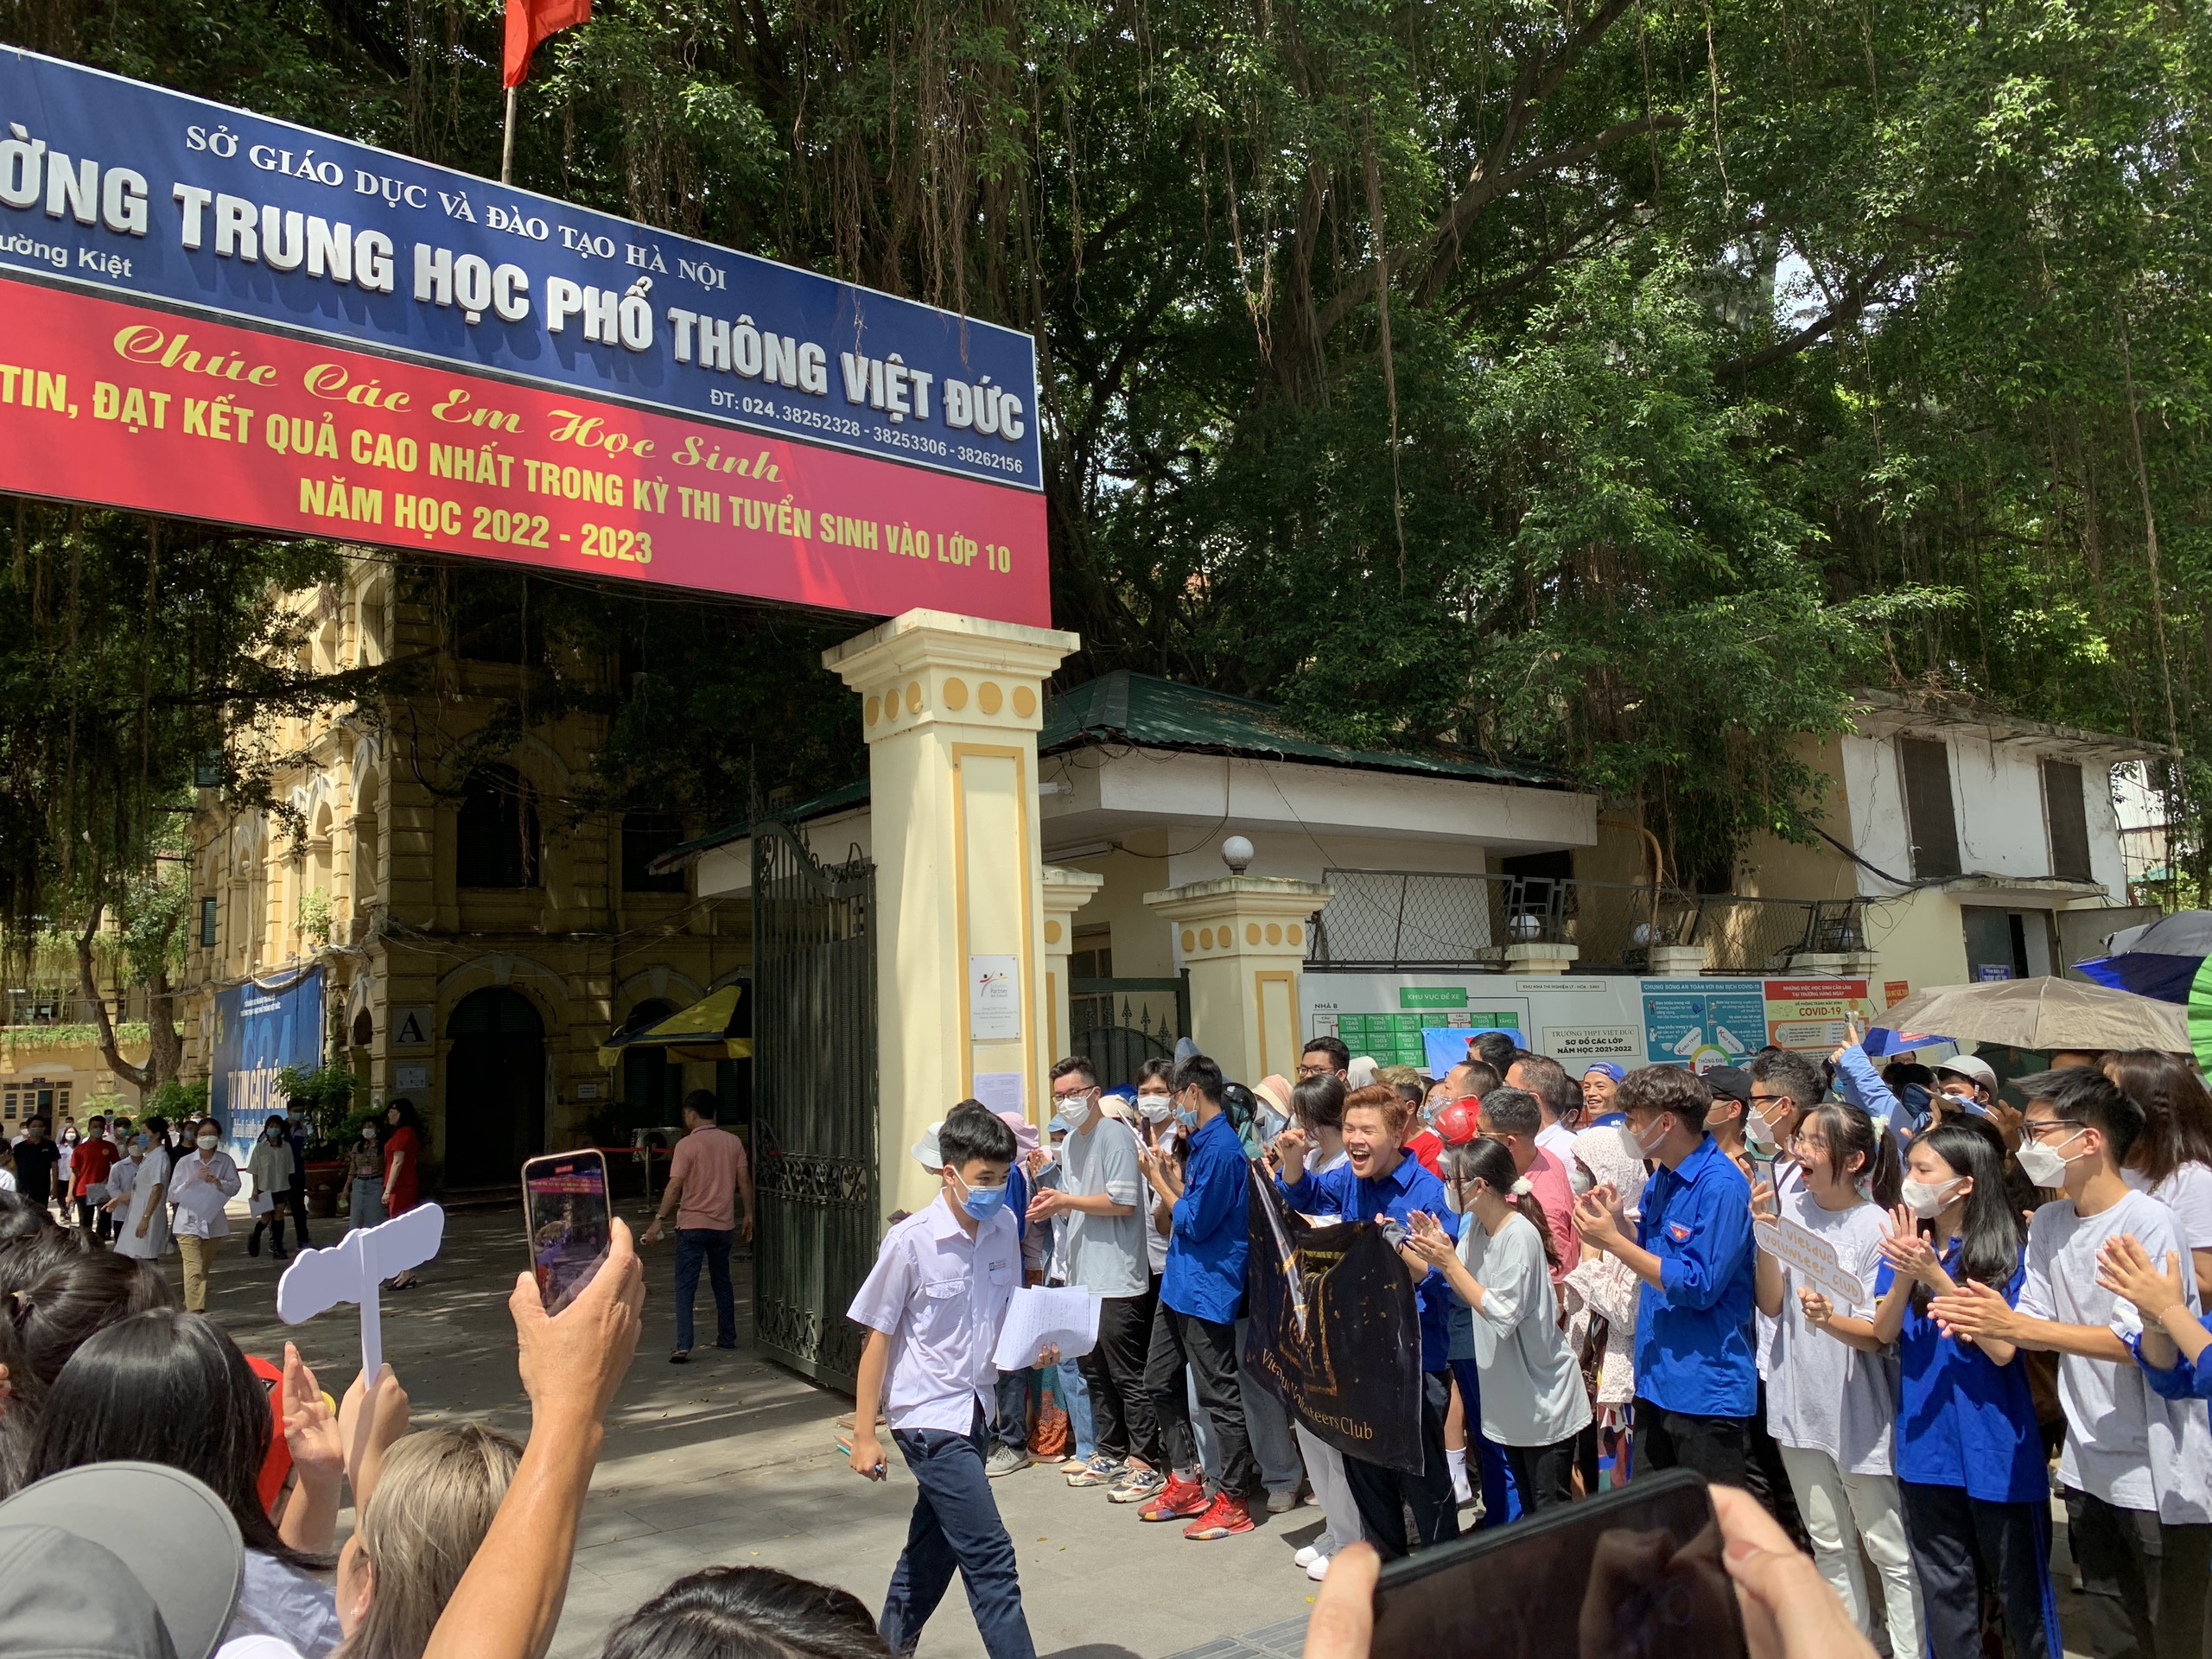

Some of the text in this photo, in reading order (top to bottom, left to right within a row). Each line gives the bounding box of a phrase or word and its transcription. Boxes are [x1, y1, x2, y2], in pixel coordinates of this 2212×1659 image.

[187, 124, 727, 291] SỞ GIÁO DỤC VÀ ĐÀO TẠO HÀ NỘI
[79, 248, 132, 279] Kiệt
[174, 182, 394, 294] TRUNG
[414, 243, 530, 325] HỌC
[547, 276, 653, 352] PHỔ
[668, 307, 828, 396] THÔNG
[840, 353, 932, 423] VIỆT
[943, 375, 1024, 441] ĐỨC
[114, 325, 783, 483] Chúc Các Em Học Sinh
[709, 389, 740, 410] ĐT:
[742, 394, 861, 437] 024.38252328
[873, 425, 947, 457] 38253306
[957, 447, 1024, 474] 38262156
[0, 364, 1011, 574] TIN, ĐẠT KẾT QUẢ CAO NHẤT TRONG KỲ THI TUYỂN SINH VÀO LỚP 10
[299, 476, 382, 524] NĂM
[394, 493, 461, 539] HỌC
[473, 505, 550, 549] 2022
[581, 523, 652, 563] 2023
[397, 1012, 427, 1042] A
[1799, 1007, 1841, 1016] COVID-19
[238, 1071, 250, 1109] TIN
[1340, 1416, 1373, 1440] Club
